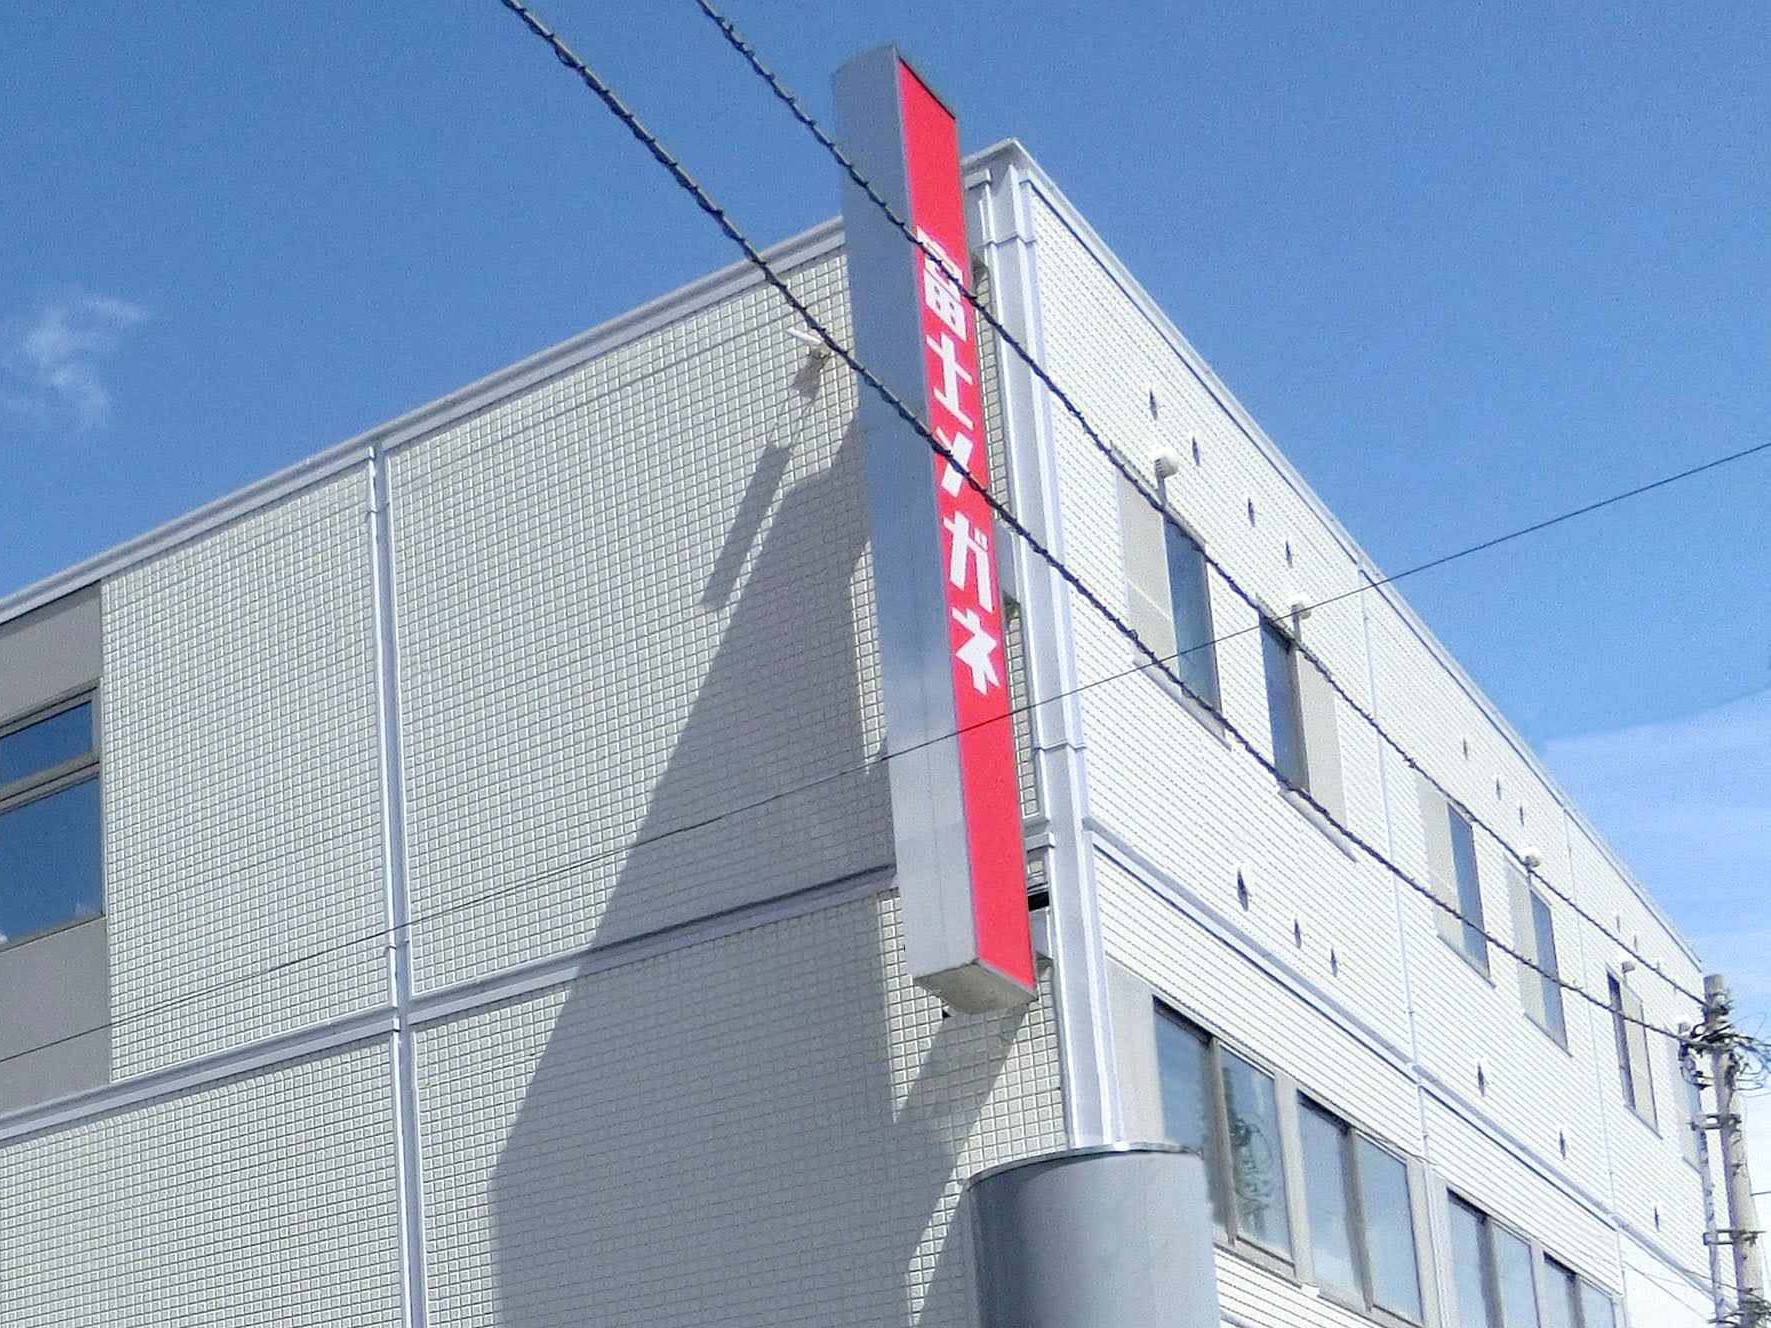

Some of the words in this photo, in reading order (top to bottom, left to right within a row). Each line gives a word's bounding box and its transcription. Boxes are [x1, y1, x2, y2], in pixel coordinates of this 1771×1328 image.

[916, 225, 1000, 695] 富士メガネ
